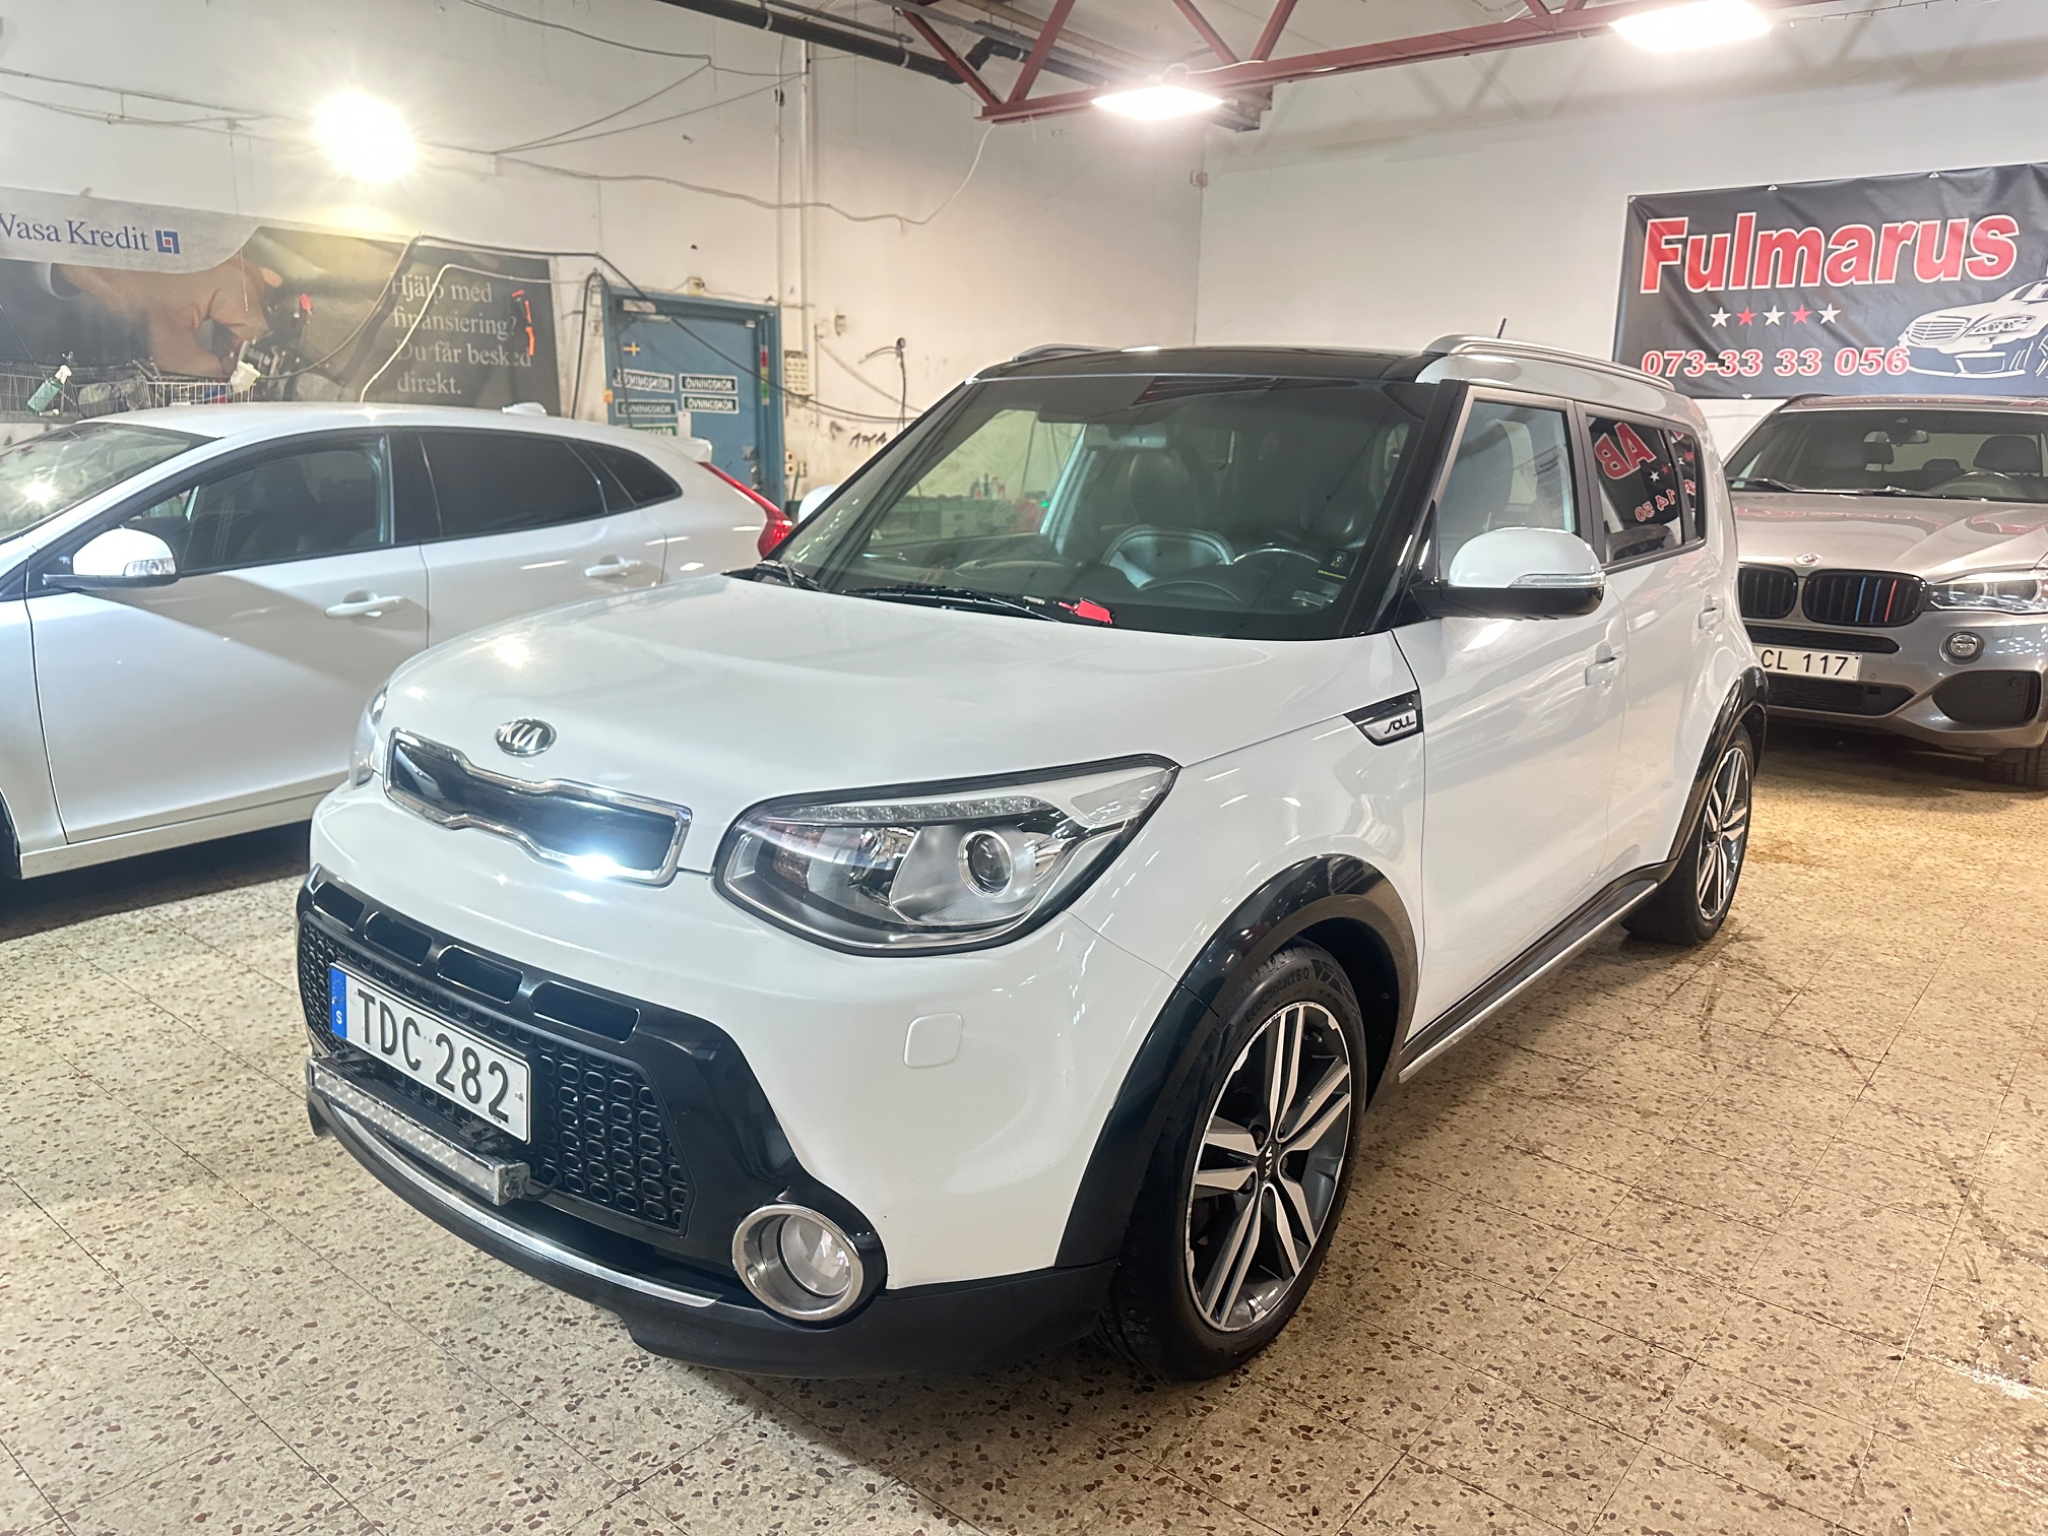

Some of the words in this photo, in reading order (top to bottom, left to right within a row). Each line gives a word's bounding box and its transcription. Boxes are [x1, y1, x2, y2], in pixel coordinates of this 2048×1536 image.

[0, 213, 61, 242] Vasa
[65, 219, 150, 251] Kredit
[1639, 212, 2020, 294] Fulmarus
[391, 274, 444, 305] Hjälp
[451, 282, 492, 302] med
[393, 305, 517, 341] finansiering?
[396, 339, 427, 361] Du
[435, 340, 461, 364] får
[1641, 349, 1763, 377] 073-33
[1774, 348, 1822, 376] 33
[1834, 347, 1910, 376] 056
[396, 371, 462, 395] direkt.
[1803, 653, 1849, 676] 117
[335, 1009, 343, 1025] S
[357, 988, 421, 1071] TDC
[435, 1032, 509, 1124] 282
